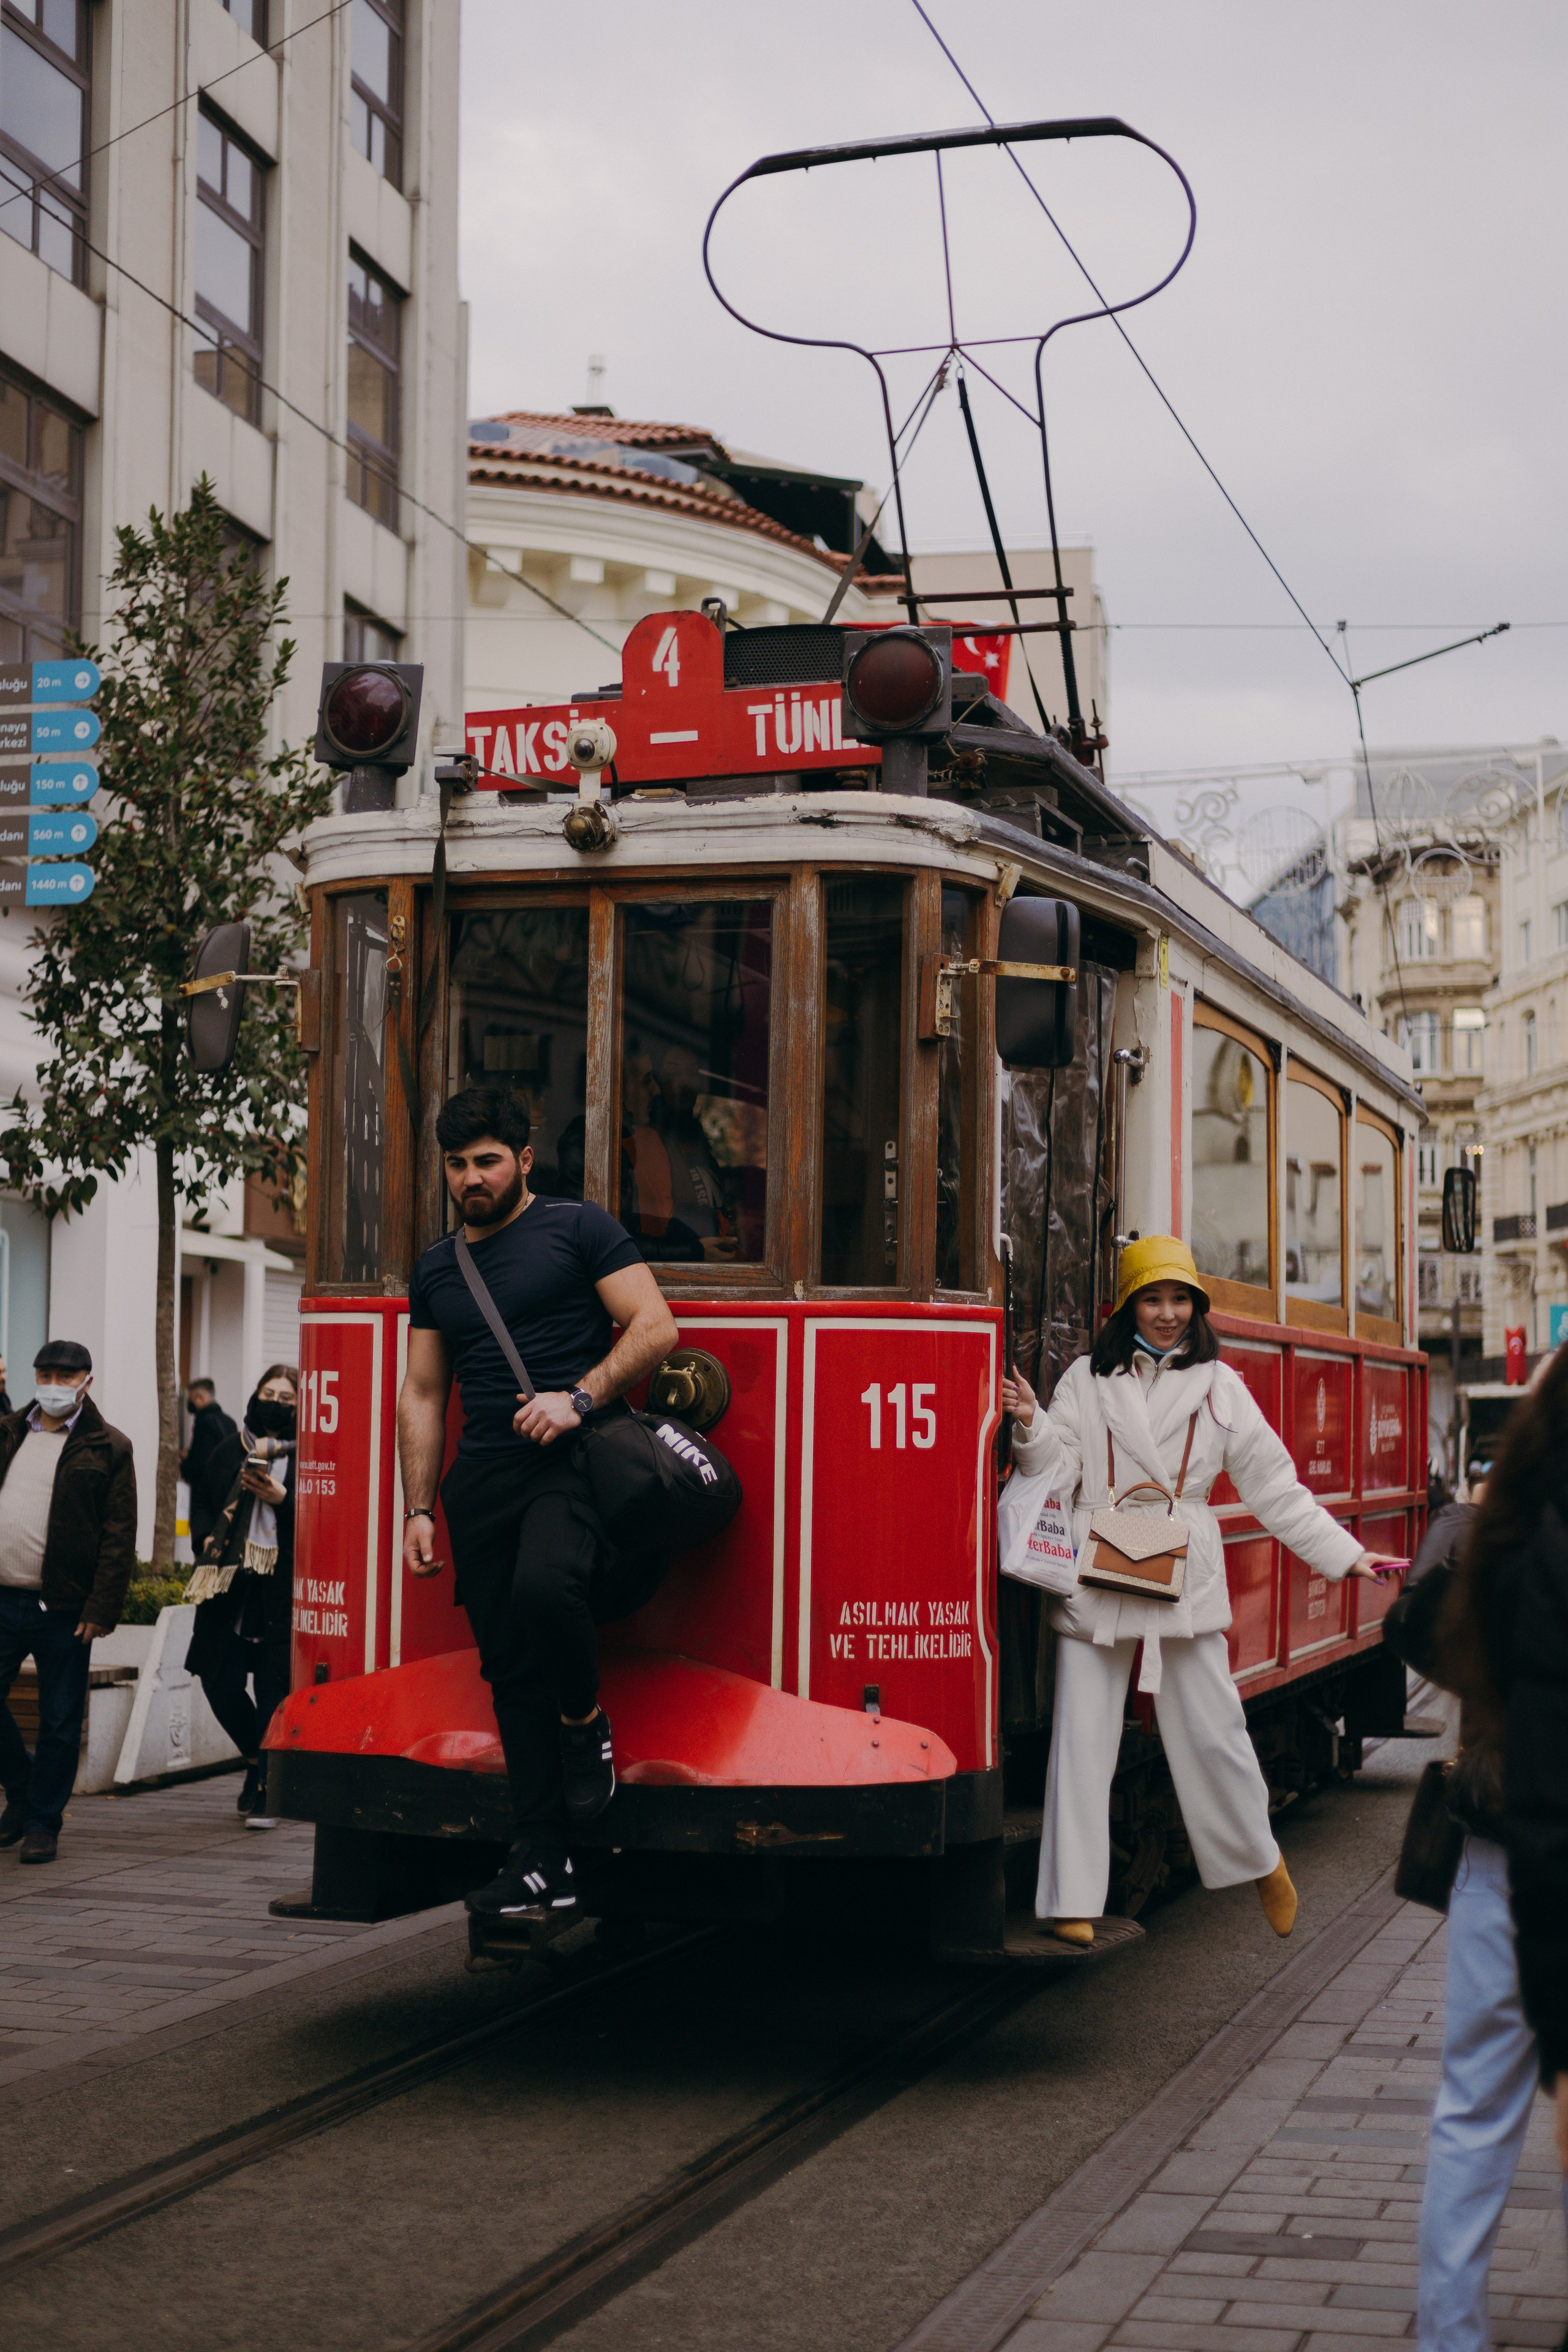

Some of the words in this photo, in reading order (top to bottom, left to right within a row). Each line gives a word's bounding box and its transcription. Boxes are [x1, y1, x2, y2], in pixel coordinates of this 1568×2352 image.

[653, 627, 680, 687] 4
[37, 677, 50, 688] 20
[37, 726, 50, 737] 50
[36, 778, 55, 790] 150
[56, 780, 66, 789] m
[33, 829, 53, 840] 560
[54, 831, 64, 839] m
[31, 878, 56, 890] 1440
[301, 1370, 339, 1433] 115
[861, 1383, 936, 1449] 115
[655, 1423, 718, 1485] NIKE
[315, 1479, 336, 1496] 153
[307, 1579, 345, 1605] YASAK
[840, 1602, 919, 1626] ASILMAK
[928, 1600, 969, 1626] YASAK
[830, 1634, 855, 1659] VE
[866, 1630, 971, 1659] TEHLİKELİDİR
